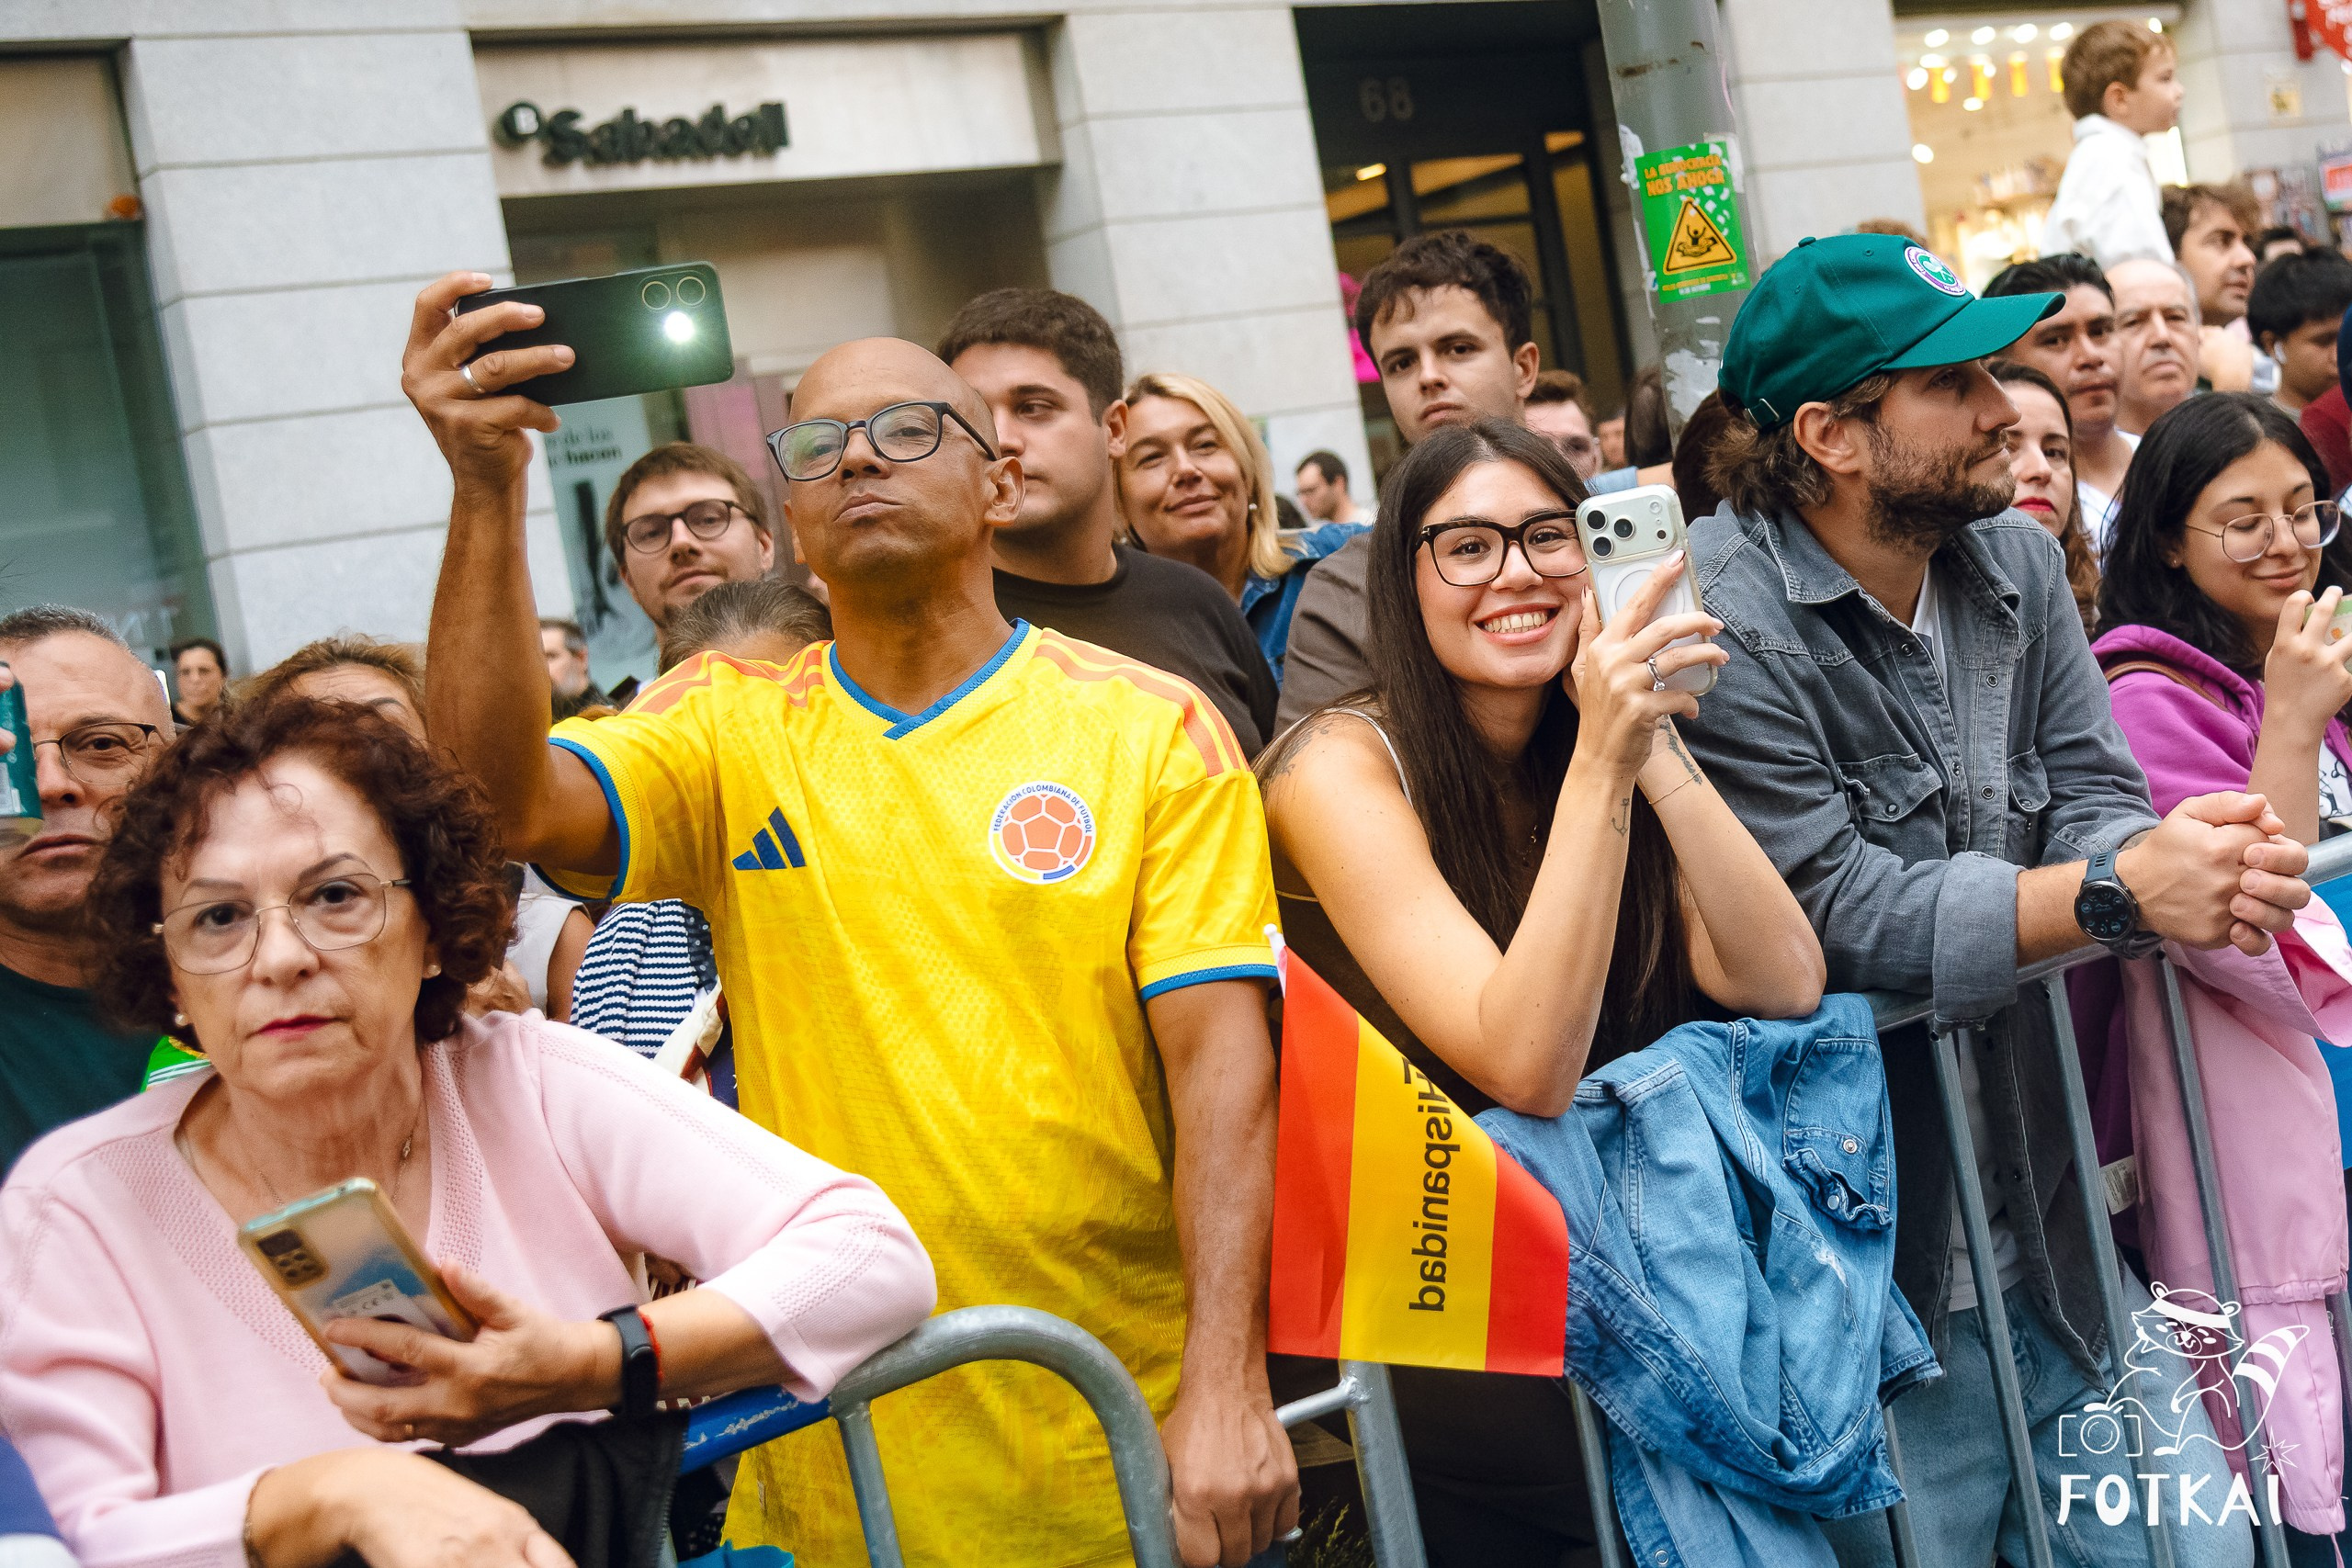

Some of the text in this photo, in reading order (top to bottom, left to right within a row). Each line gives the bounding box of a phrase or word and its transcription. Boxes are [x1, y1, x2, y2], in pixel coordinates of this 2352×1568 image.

[1360, 77, 1414, 122] 68
[548, 102, 788, 165] Sabadell
[1644, 166, 1657, 179] LA
[1646, 168, 1724, 196] NOS AHOGA
[1022, 784, 1071, 799] COLOMBIANA
[1070, 796, 1080, 807] DE
